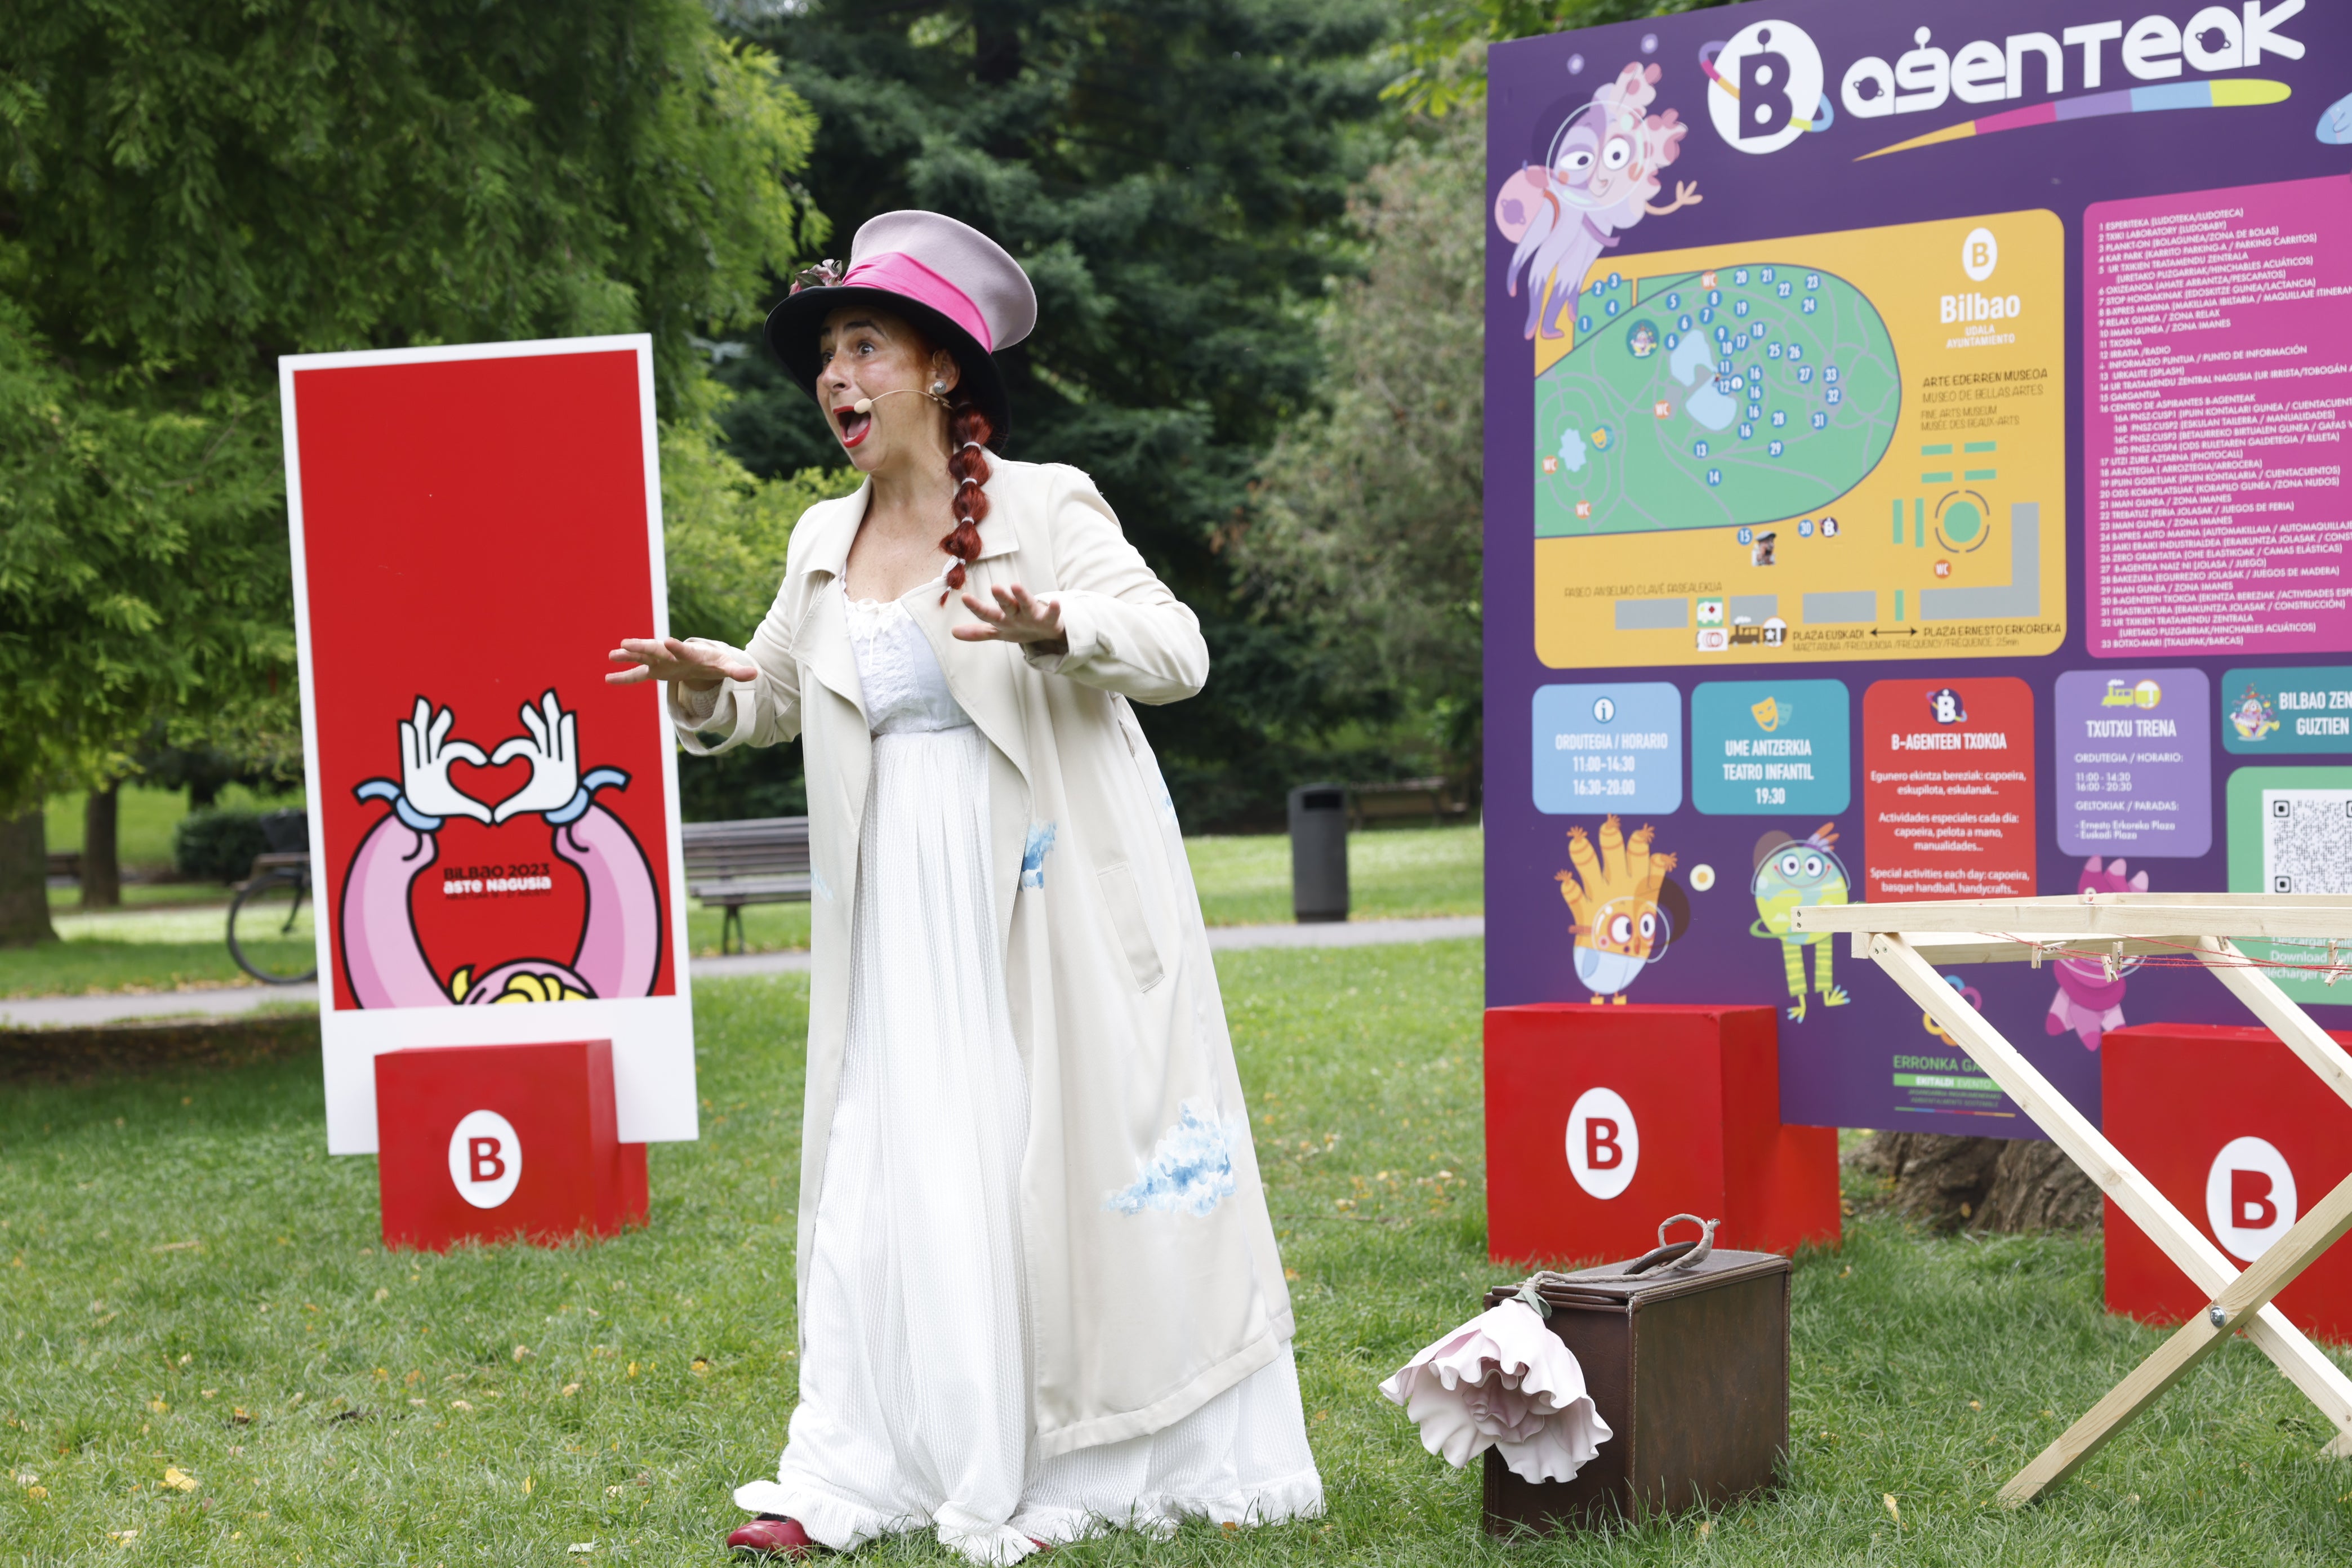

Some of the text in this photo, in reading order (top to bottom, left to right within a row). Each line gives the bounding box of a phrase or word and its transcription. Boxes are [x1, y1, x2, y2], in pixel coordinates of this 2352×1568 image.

[2106, 219, 2149, 230] ESPERITEKA
[2099, 221, 2226, 242] 2 TXIKI LABORATORY (LUDOBABY)
[1972, 242, 1990, 268] B
[1612, 275, 1617, 287] 3
[1702, 274, 1716, 286] WC
[1736, 271, 1747, 283] 20
[1762, 269, 1771, 282] 21
[1807, 275, 1818, 288] 23
[1596, 282, 1601, 294] 2
[1779, 283, 1791, 297] 22
[1671, 295, 1676, 308] 5
[1712, 292, 1717, 304] 8
[1609, 302, 1615, 313] 4
[1737, 302, 1748, 316] 19
[1803, 299, 1814, 311] 24
[1941, 293, 2020, 323] Bilbao
[1704, 309, 1709, 321] 7
[1583, 318, 1587, 329] 1
[1753, 324, 1763, 336] 18
[1965, 324, 1995, 337] UDALA
[1946, 333, 2015, 348] AYUNTAMIENTO
[2109, 338, 2142, 348] TXOSNA
[1769, 344, 1780, 357] 25
[1789, 346, 1800, 359] 26
[1799, 368, 1810, 381] 27
[1826, 368, 1836, 381] 33
[1923, 368, 2047, 387] ARTE EDERREN MUSEOA
[1828, 390, 1838, 402] 32
[1923, 384, 2043, 403] MUSEO DE BELLAS ARTES
[2100, 390, 2161, 402] 15 GARGANTUA
[2110, 402, 2142, 412] CENTRO
[2144, 401, 2154, 409] DE
[2156, 398, 2203, 408] ASPIRANTES
[2205, 394, 2255, 405] B-AGENTEAK
[1773, 413, 1784, 425] 28
[1921, 406, 1997, 419] FINE ARTS MUSEUM
[1950, 419, 1966, 429] DES
[1697, 444, 1708, 457] 13
[1770, 442, 1781, 455] 29
[2110, 457, 2127, 466] UTZI
[2130, 455, 2149, 465] ZURE
[2151, 453, 2189, 463] AZTARNA
[2190, 449, 2243, 462] (PHOTOCALL)
[1709, 471, 1721, 485] 14
[1799, 522, 1812, 536] 30
[1565, 587, 1591, 597] PASEO
[1593, 585, 1634, 596] ANSELMO
[1793, 630, 1864, 641] PLAZA EUSKADI
[1924, 624, 2061, 637] PLAZA ERNESTO ERKOREKA
[2279, 692, 2326, 710] BILBAO
[2086, 720, 2176, 737] TXUTXU TRENA
[2296, 718, 2349, 735] GUZTIEN
[1556, 734, 1612, 750] ORDUTEGIA
[1622, 733, 1668, 749] HORARIO
[1725, 740, 1811, 756] UME ANTZERKIA
[1892, 733, 2007, 750] B-AGENTEEN TXOKOA
[1573, 756, 1634, 772] 11:00-14:30
[2075, 753, 2127, 763] ORDUTEGIA
[2137, 752, 2182, 762] HORARIO:
[1723, 764, 1814, 780] TEATRO INFANTIL
[1871, 770, 2026, 783] Egunero ekintza bereziak: capoeira,
[2077, 772, 2099, 782] 11:00
[2107, 772, 2130, 782] 14:30
[1574, 779, 1635, 795] 16:30-20:00
[2077, 782, 2100, 791] 16:00
[2106, 782, 2132, 791] 20:30
[1756, 787, 1785, 804] 19:30
[2075, 801, 2124, 810] GELTOKIAK
[2134, 801, 2178, 810] PARADAS:
[1879, 812, 2019, 824] Actividades especiales cada día:
[1895, 827, 1935, 838] capoeira,
[1936, 826, 1965, 838] pelota
[1974, 829, 2002, 838] mano,
[2081, 821, 2175, 831] Ernesto Erkoreka Plaza
[2081, 830, 2137, 839] Euskadi Plaza
[508, 863, 550, 876] 2023
[1870, 867, 2029, 881] Special activities each day: capoeira,
[1881, 882, 1914, 894] basque
[1916, 883, 1957, 893] handball,
[2270, 950, 2327, 963] Download
[1894, 1055, 1959, 1071] ERRONKA
[1916, 1076, 1992, 1089] EKITALDI EVENTO
[1585, 1117, 1623, 1170] B
[467, 1137, 506, 1182] B
[2231, 1169, 2277, 1230] B
